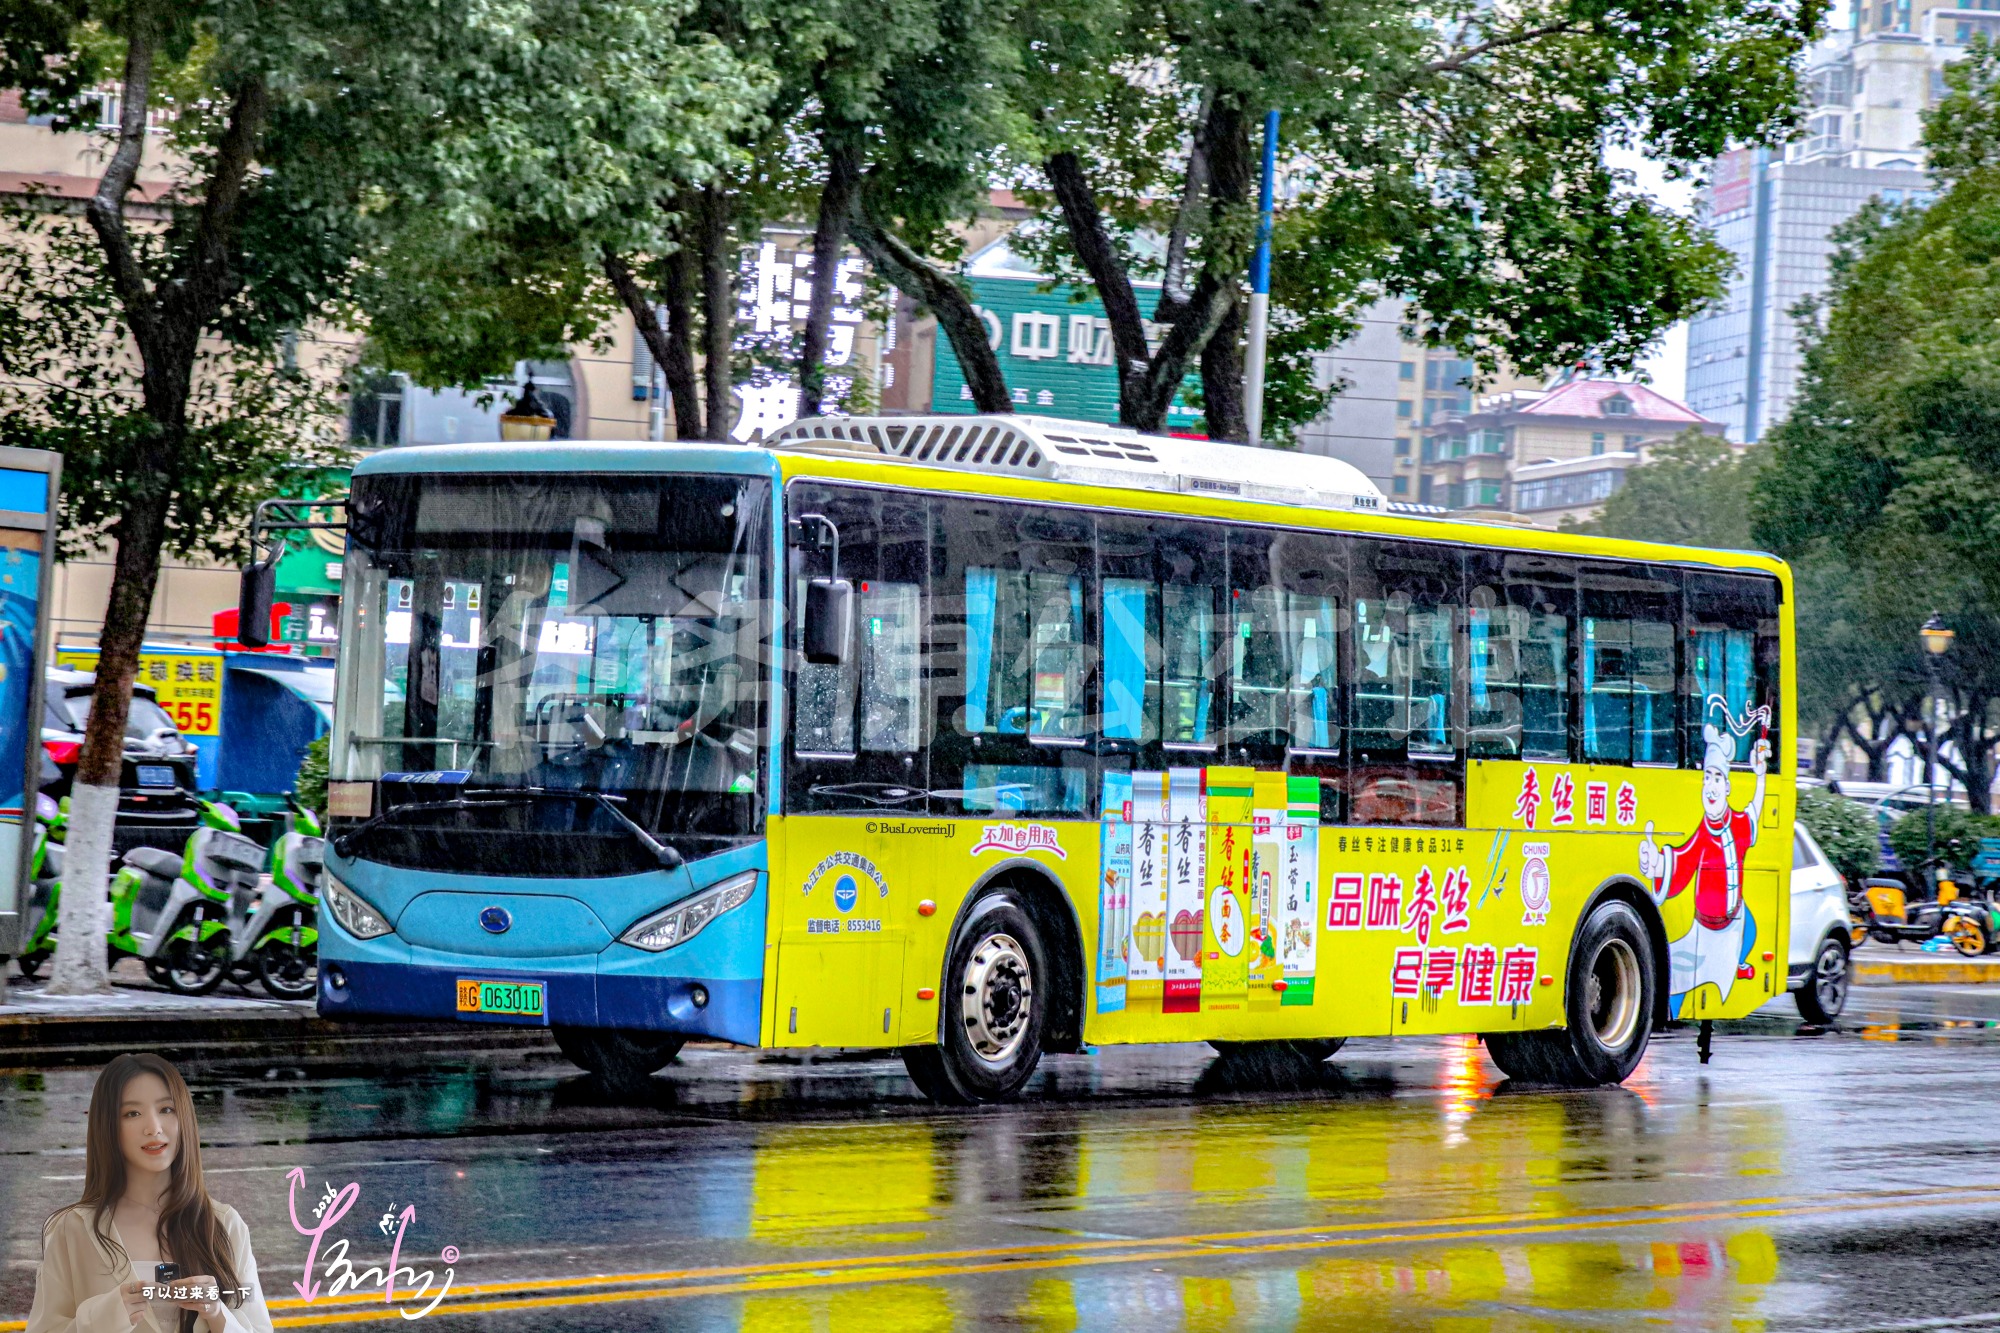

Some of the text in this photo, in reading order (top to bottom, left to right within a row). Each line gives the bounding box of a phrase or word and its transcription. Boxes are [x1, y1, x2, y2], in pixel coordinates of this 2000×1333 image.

[1514, 767, 1636, 829] 春丝面条
[984, 825, 1057, 848] 不加食用胶
[1523, 844, 1549, 855] CHUNSI
[802, 851, 889, 897] 九江市公共交通集团公司
[1328, 868, 1469, 945] 品味春丝
[1393, 947, 1537, 1002] 尽享健康
